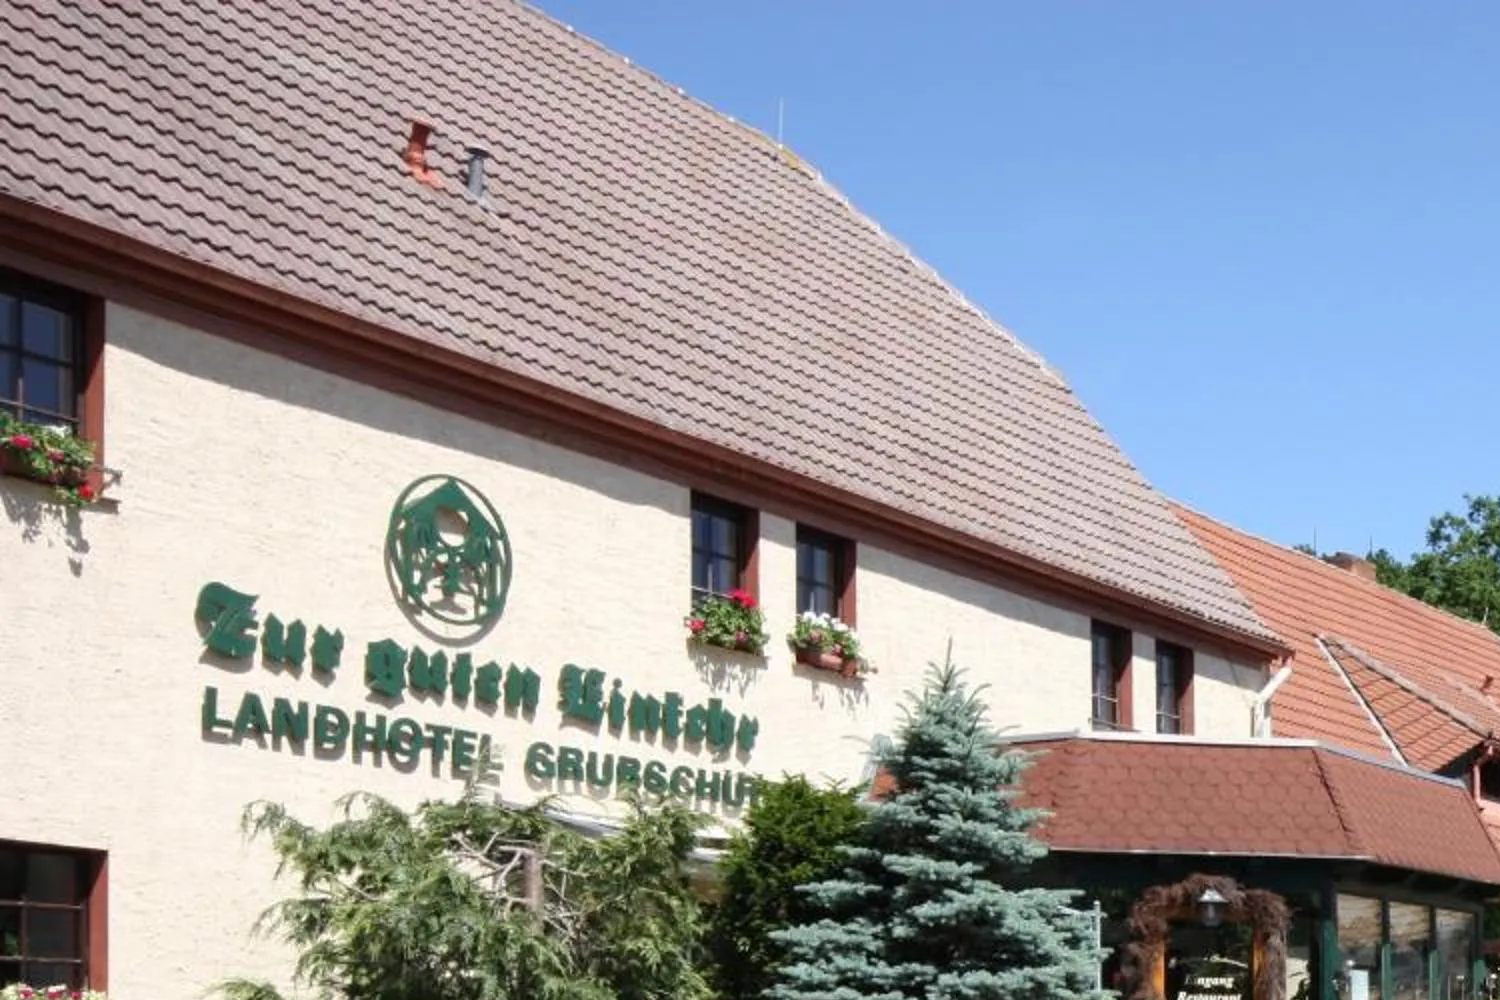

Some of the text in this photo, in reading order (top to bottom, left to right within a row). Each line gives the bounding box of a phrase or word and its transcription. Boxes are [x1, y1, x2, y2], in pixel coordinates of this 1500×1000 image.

[195, 582, 344, 675] Zur
[365, 639, 541, 711] guten
[202, 686, 504, 772] LANDHOTEL
